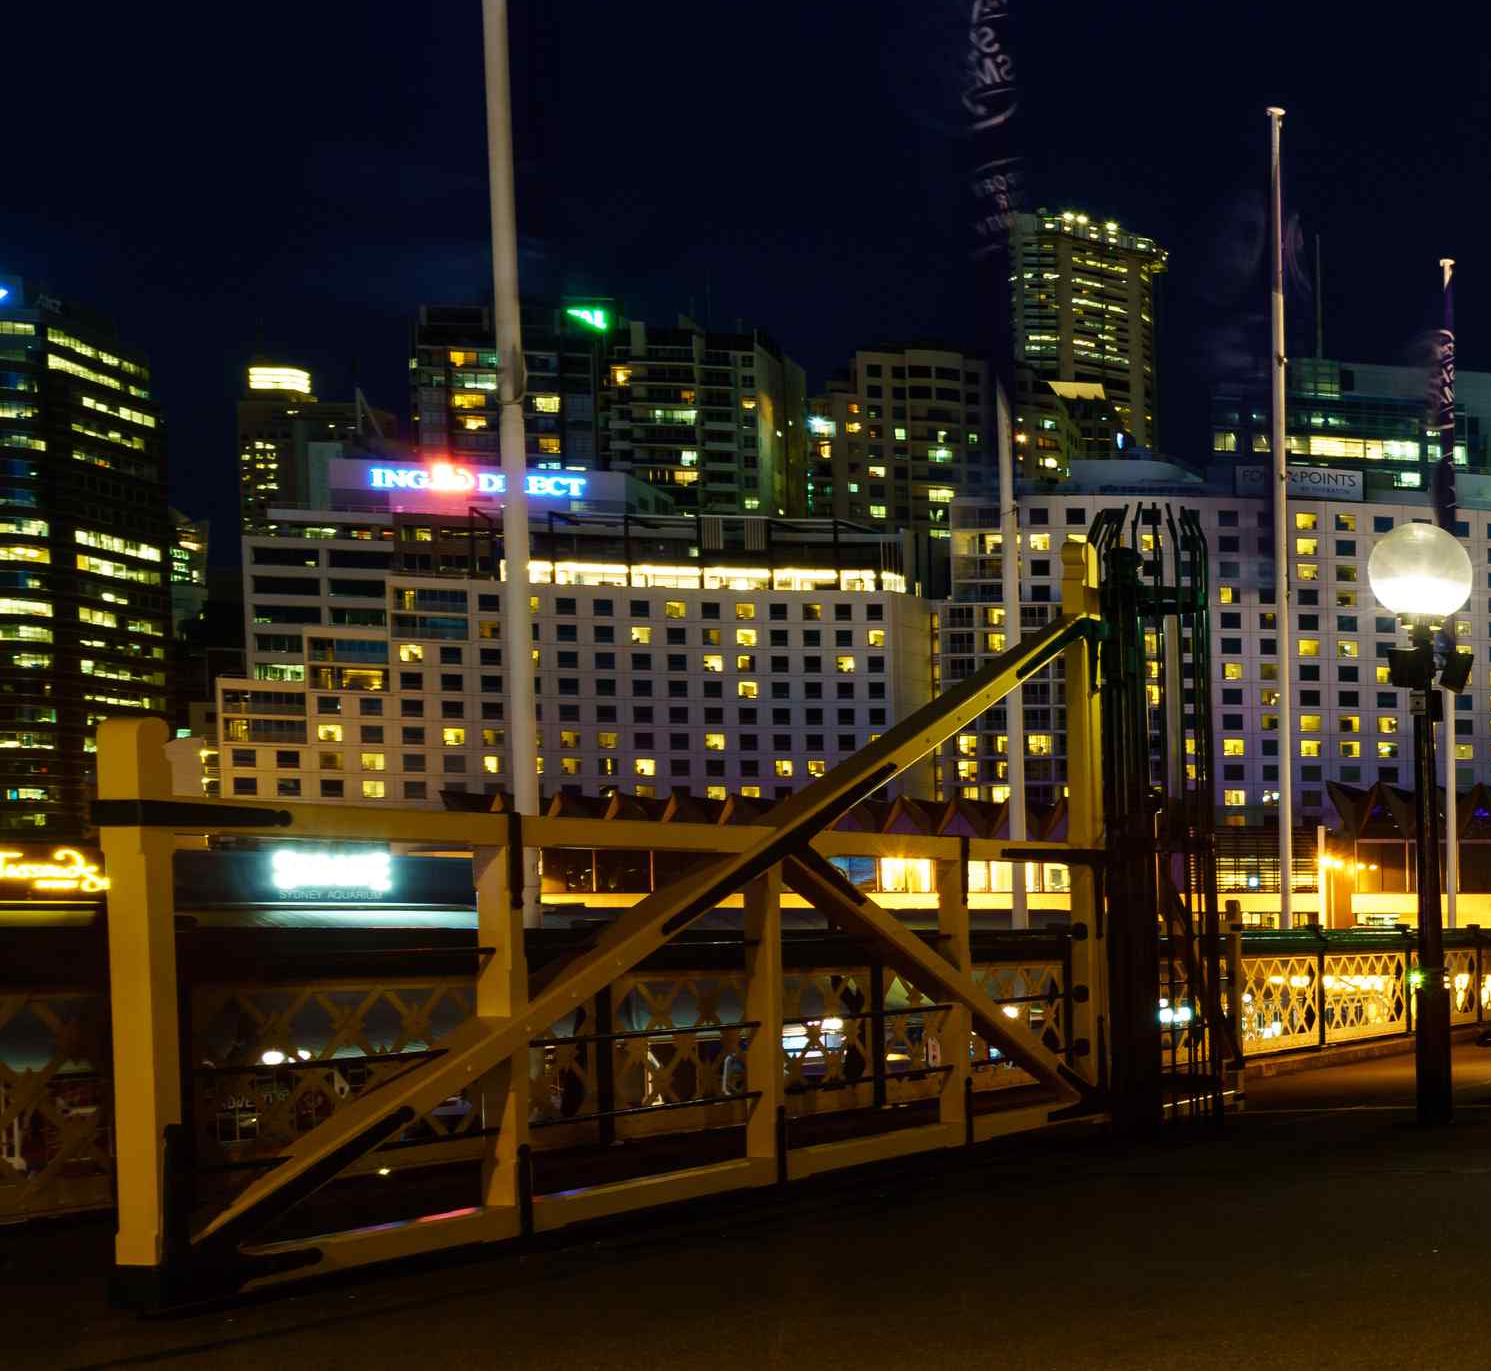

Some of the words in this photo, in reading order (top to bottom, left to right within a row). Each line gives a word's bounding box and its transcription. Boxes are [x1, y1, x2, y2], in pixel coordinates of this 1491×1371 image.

[370, 467, 428, 489] ING
[479, 473, 586, 496] DIECT
[1300, 470, 1357, 487] POINTS
[279, 890, 321, 900] SYDNEY
[327, 890, 383, 901] AQUARIUM
